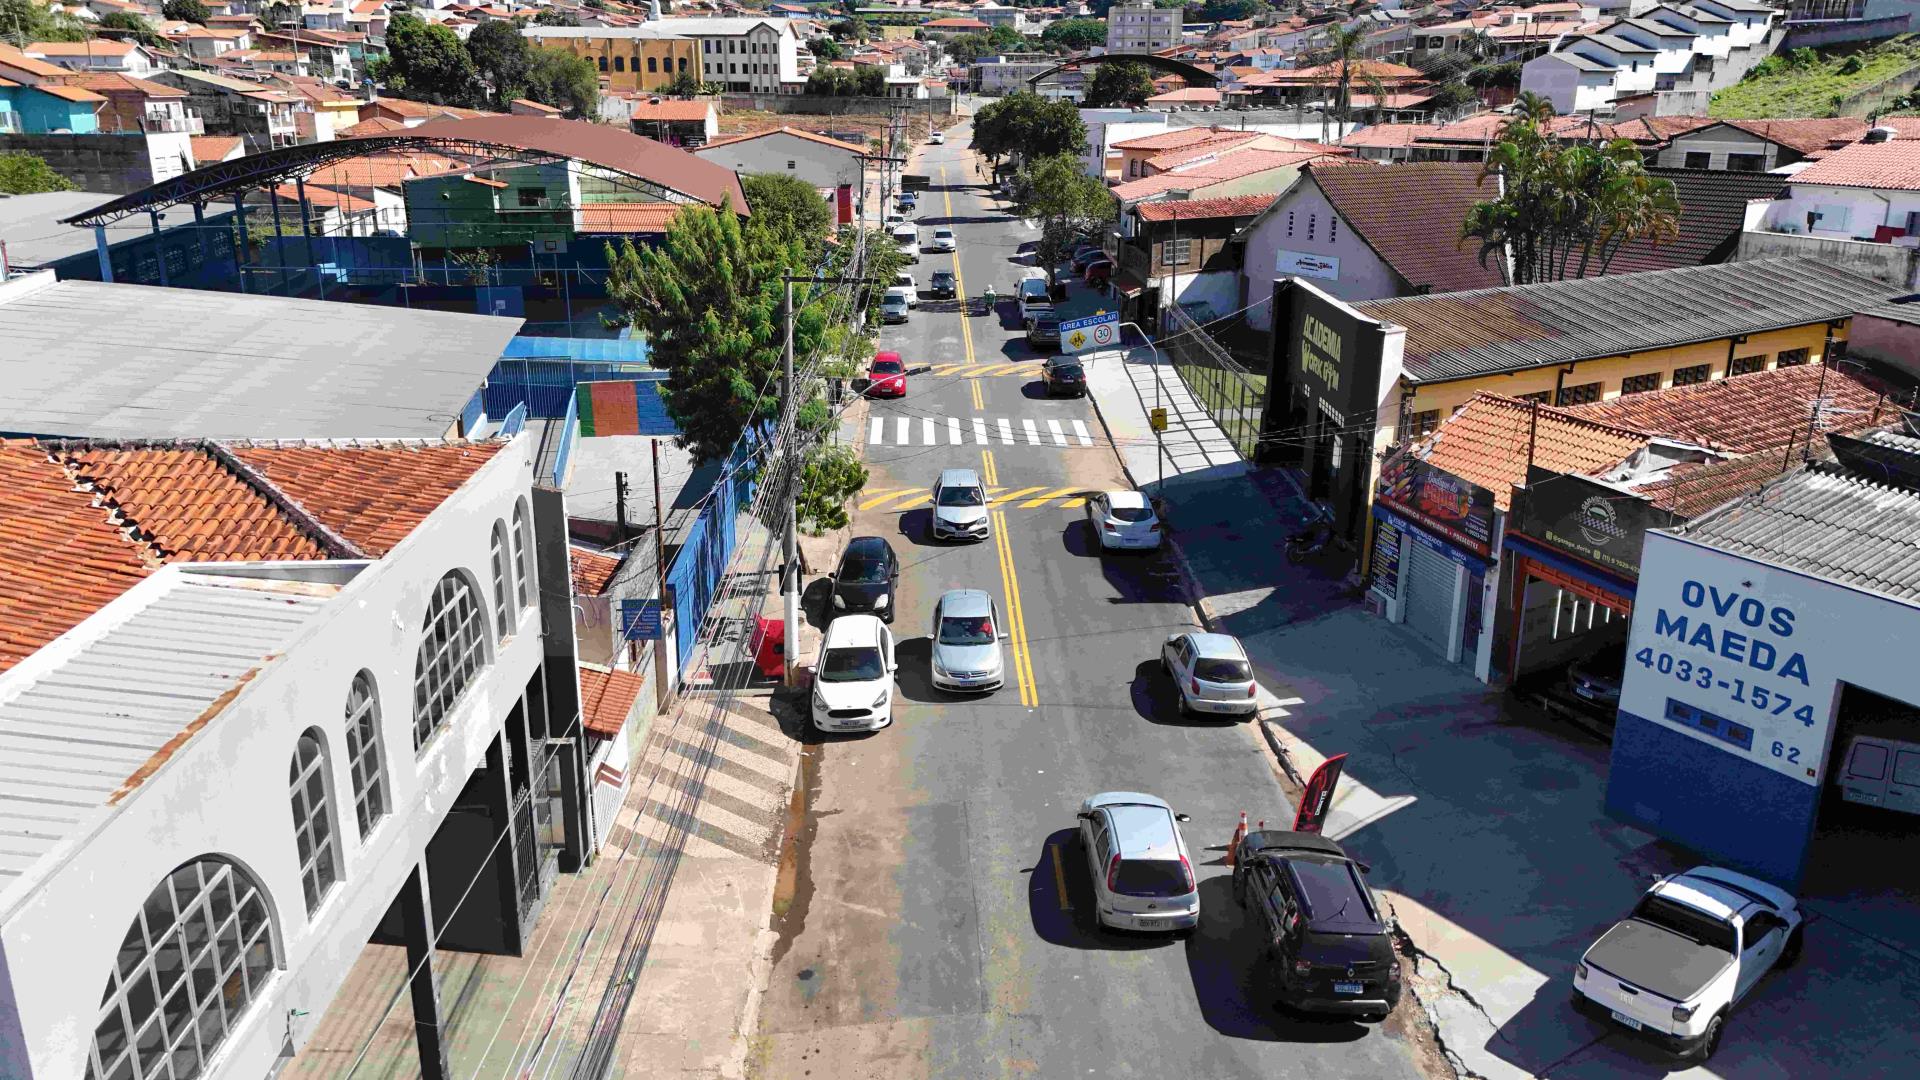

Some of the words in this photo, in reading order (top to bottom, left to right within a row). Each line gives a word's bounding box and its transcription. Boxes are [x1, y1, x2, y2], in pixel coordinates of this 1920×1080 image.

[1083, 313, 1117, 326] ESCOLAR
[1097, 328, 1109, 339] 30
[1302, 314, 1341, 363] ACADEMIA
[1453, 532, 1479, 550] PRESENTES
[1682, 580, 1795, 637] OVOS
[1655, 608, 1810, 687] MAEDA
[1635, 647, 1815, 728] 4033-1574
[1771, 741, 1800, 765] 62
